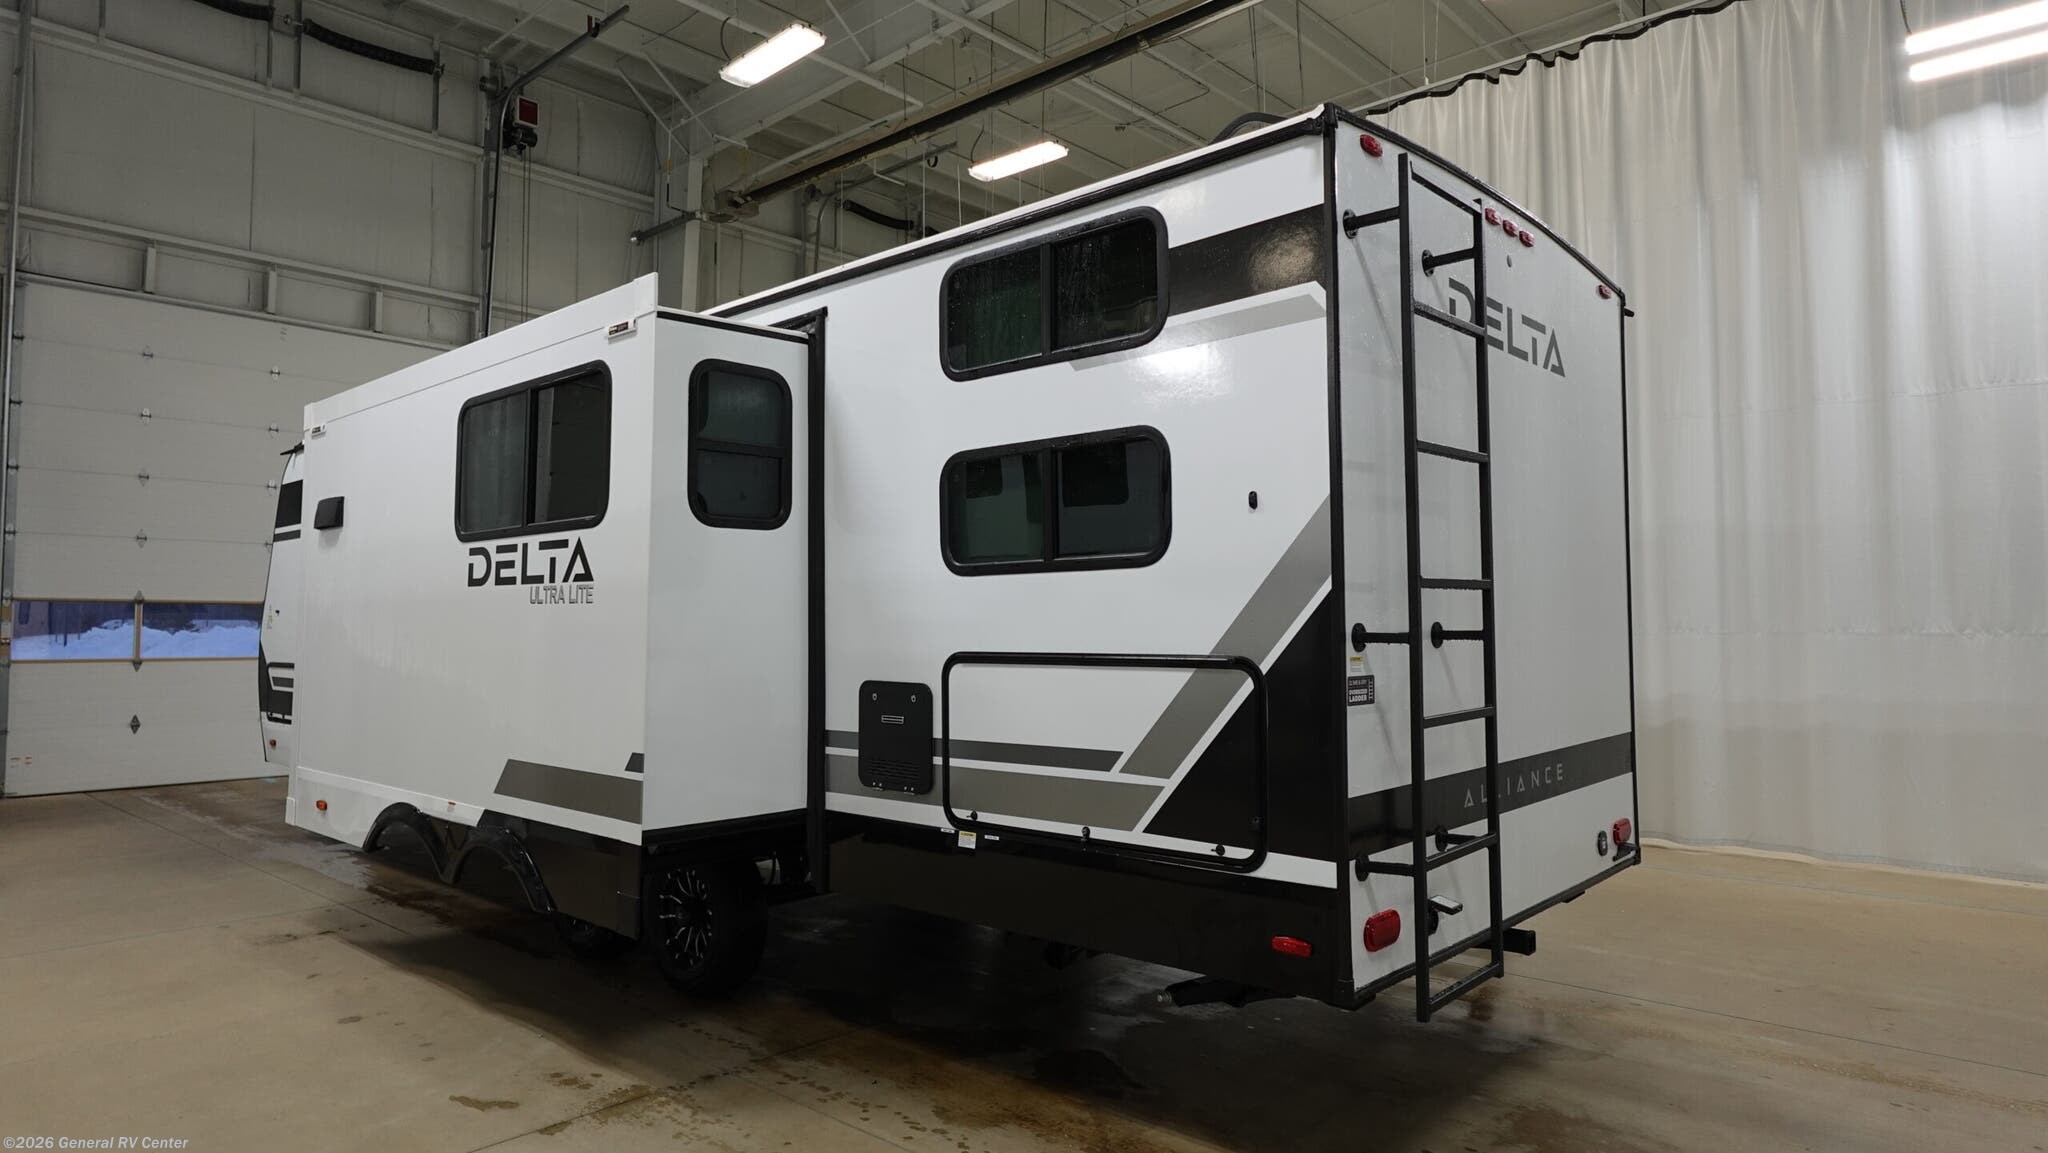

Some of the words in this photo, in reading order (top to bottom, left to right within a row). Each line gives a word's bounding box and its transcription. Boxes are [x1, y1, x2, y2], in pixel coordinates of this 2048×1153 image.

[1449, 277, 1566, 377] DELTA
[467, 536, 594, 587] DELTA
[529, 585, 565, 604] ULTRA
[568, 584, 594, 604] LITE
[1464, 763, 1564, 808] ALIANCE
